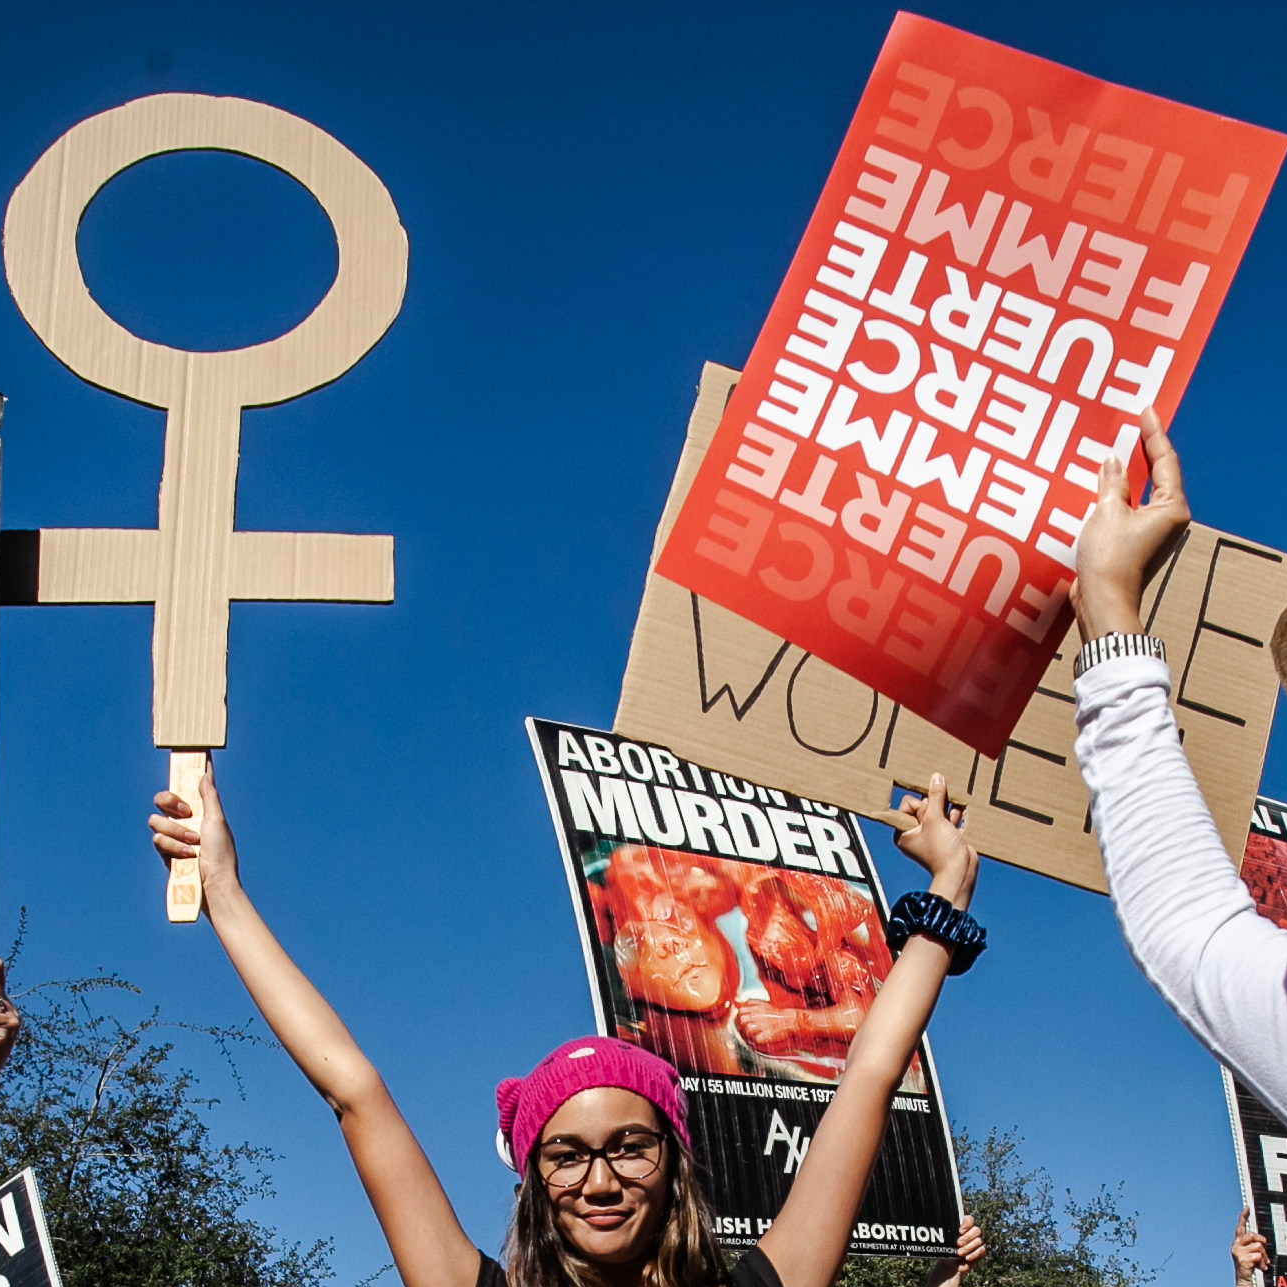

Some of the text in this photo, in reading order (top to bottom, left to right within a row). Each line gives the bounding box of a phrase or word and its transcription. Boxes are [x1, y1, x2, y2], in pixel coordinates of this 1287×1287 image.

[844, 144, 1211, 341] FEMME
[874, 59, 1251, 255] FIERCE
[784, 288, 1141, 493] FIERCE
[814, 220, 1175, 416] FUERTE
[725, 420, 1073, 645] FUERTE
[757, 357, 1098, 573] FEMME
[695, 488, 1031, 722] FIERCE
[560, 768, 866, 879] MURDER
[708, 1079, 724, 1094] 55
[725, 1080, 775, 1099] MILLION
[775, 1083, 811, 1102] SINCE
